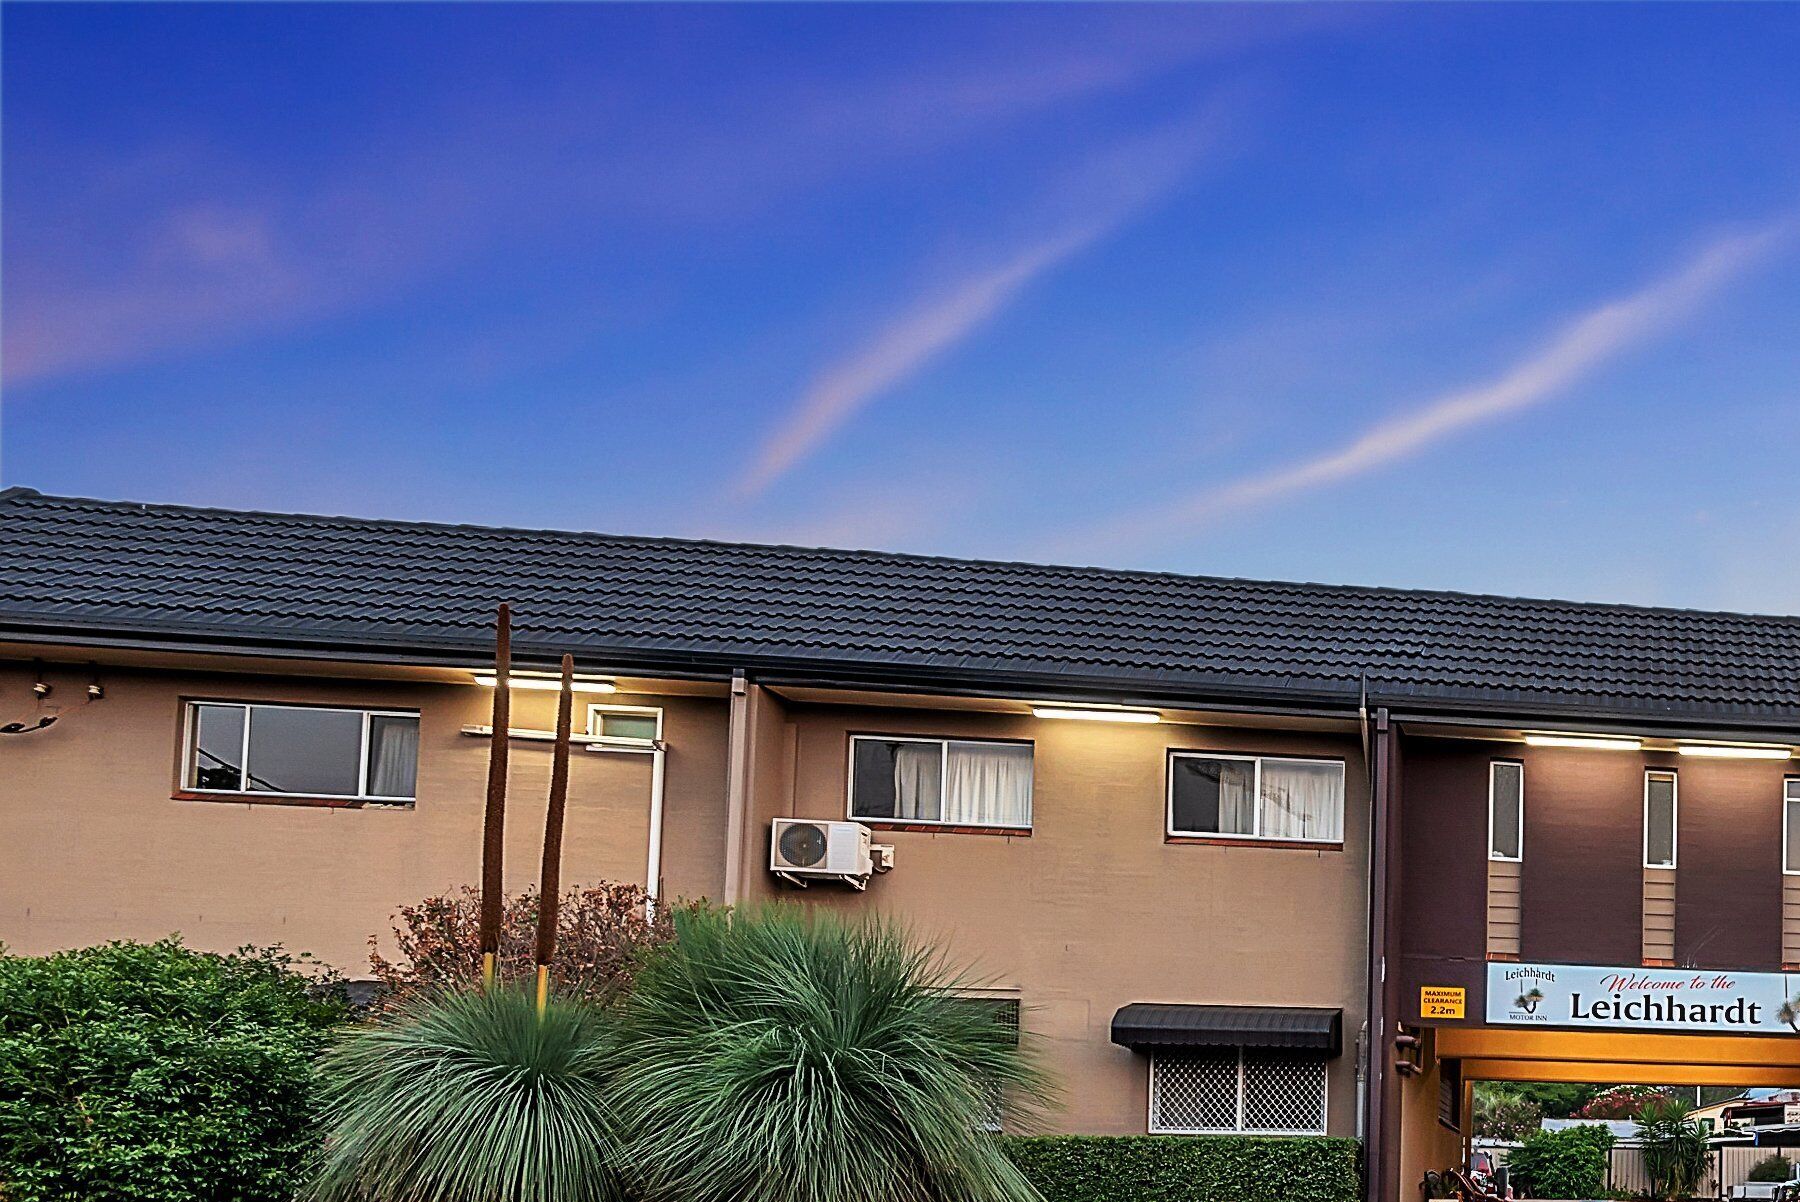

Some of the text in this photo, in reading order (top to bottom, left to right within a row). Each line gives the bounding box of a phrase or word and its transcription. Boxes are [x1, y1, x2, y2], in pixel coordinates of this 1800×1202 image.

[1505, 967, 1556, 982] Leichhardt
[1600, 973, 1736, 993] Welcome to the
[1423, 997, 1463, 1005] CLEARANCE
[1430, 1006, 1456, 1015] 2.2m
[1571, 993, 1762, 1025] Leichhardt
[1535, 1014, 1548, 1022] INN
